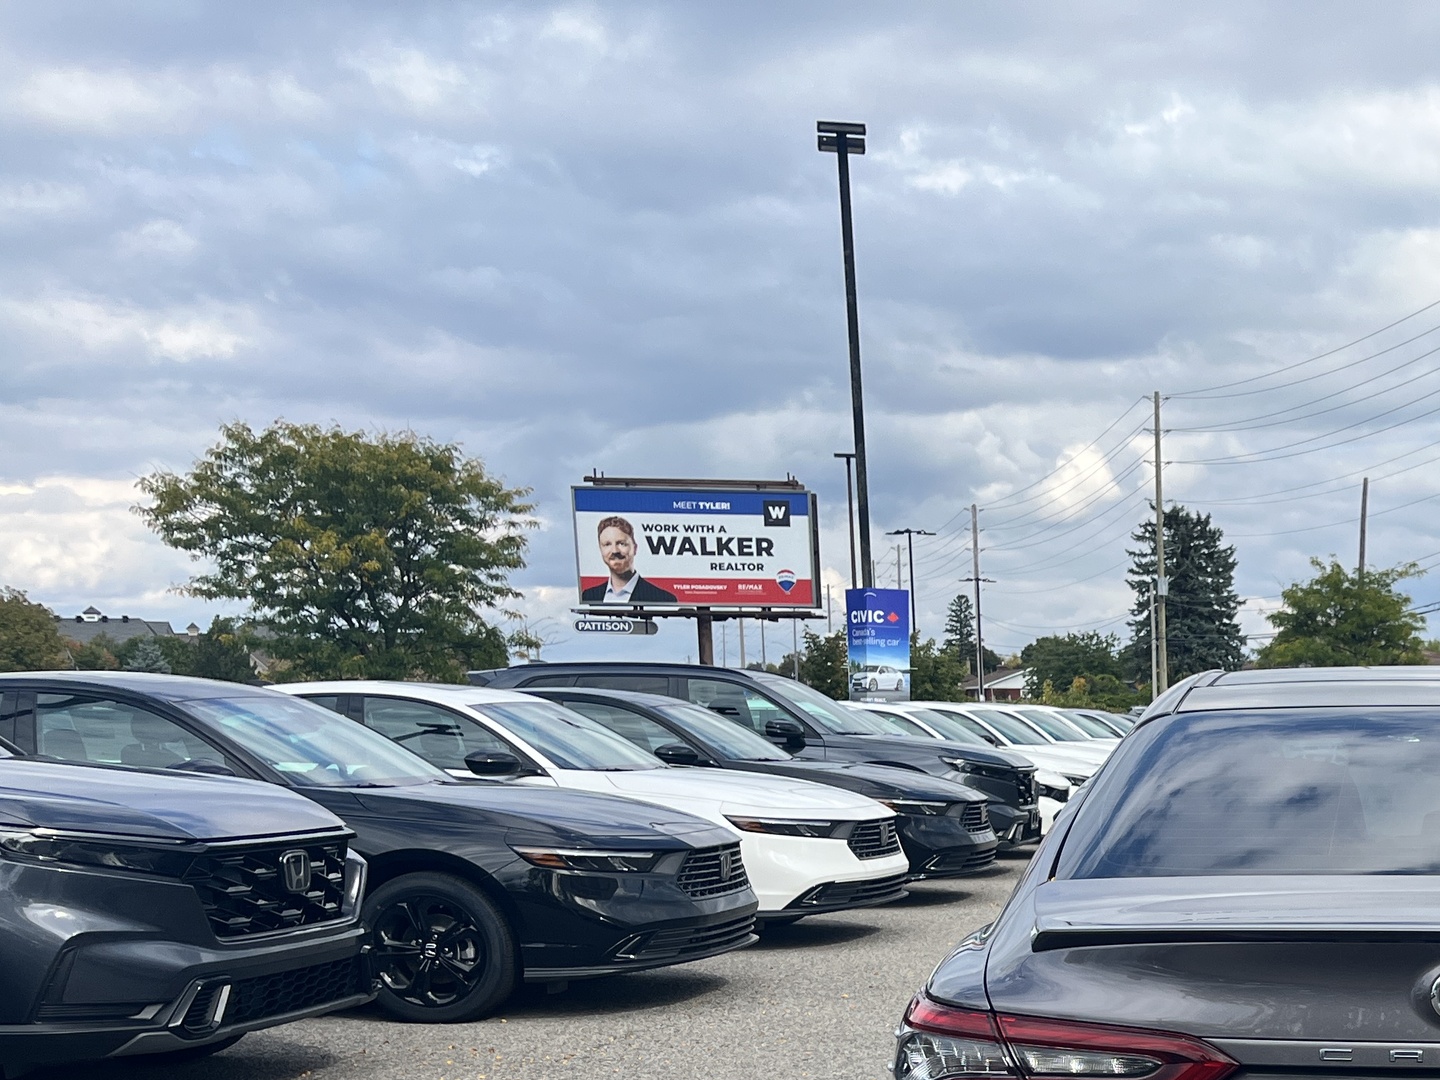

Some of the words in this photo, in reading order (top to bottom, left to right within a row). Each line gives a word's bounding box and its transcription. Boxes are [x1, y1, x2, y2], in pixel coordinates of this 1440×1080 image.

[673, 501, 697, 510] MEET
[698, 502, 730, 510] TYLER!
[767, 505, 786, 519] W
[641, 523, 680, 532] WORK
[683, 524, 715, 533] WITH
[718, 525, 727, 533] A
[645, 535, 774, 557] WALKER
[710, 562, 765, 571] REALTOR
[851, 610, 885, 623] CIVIC
[578, 621, 629, 631] PATTISON
